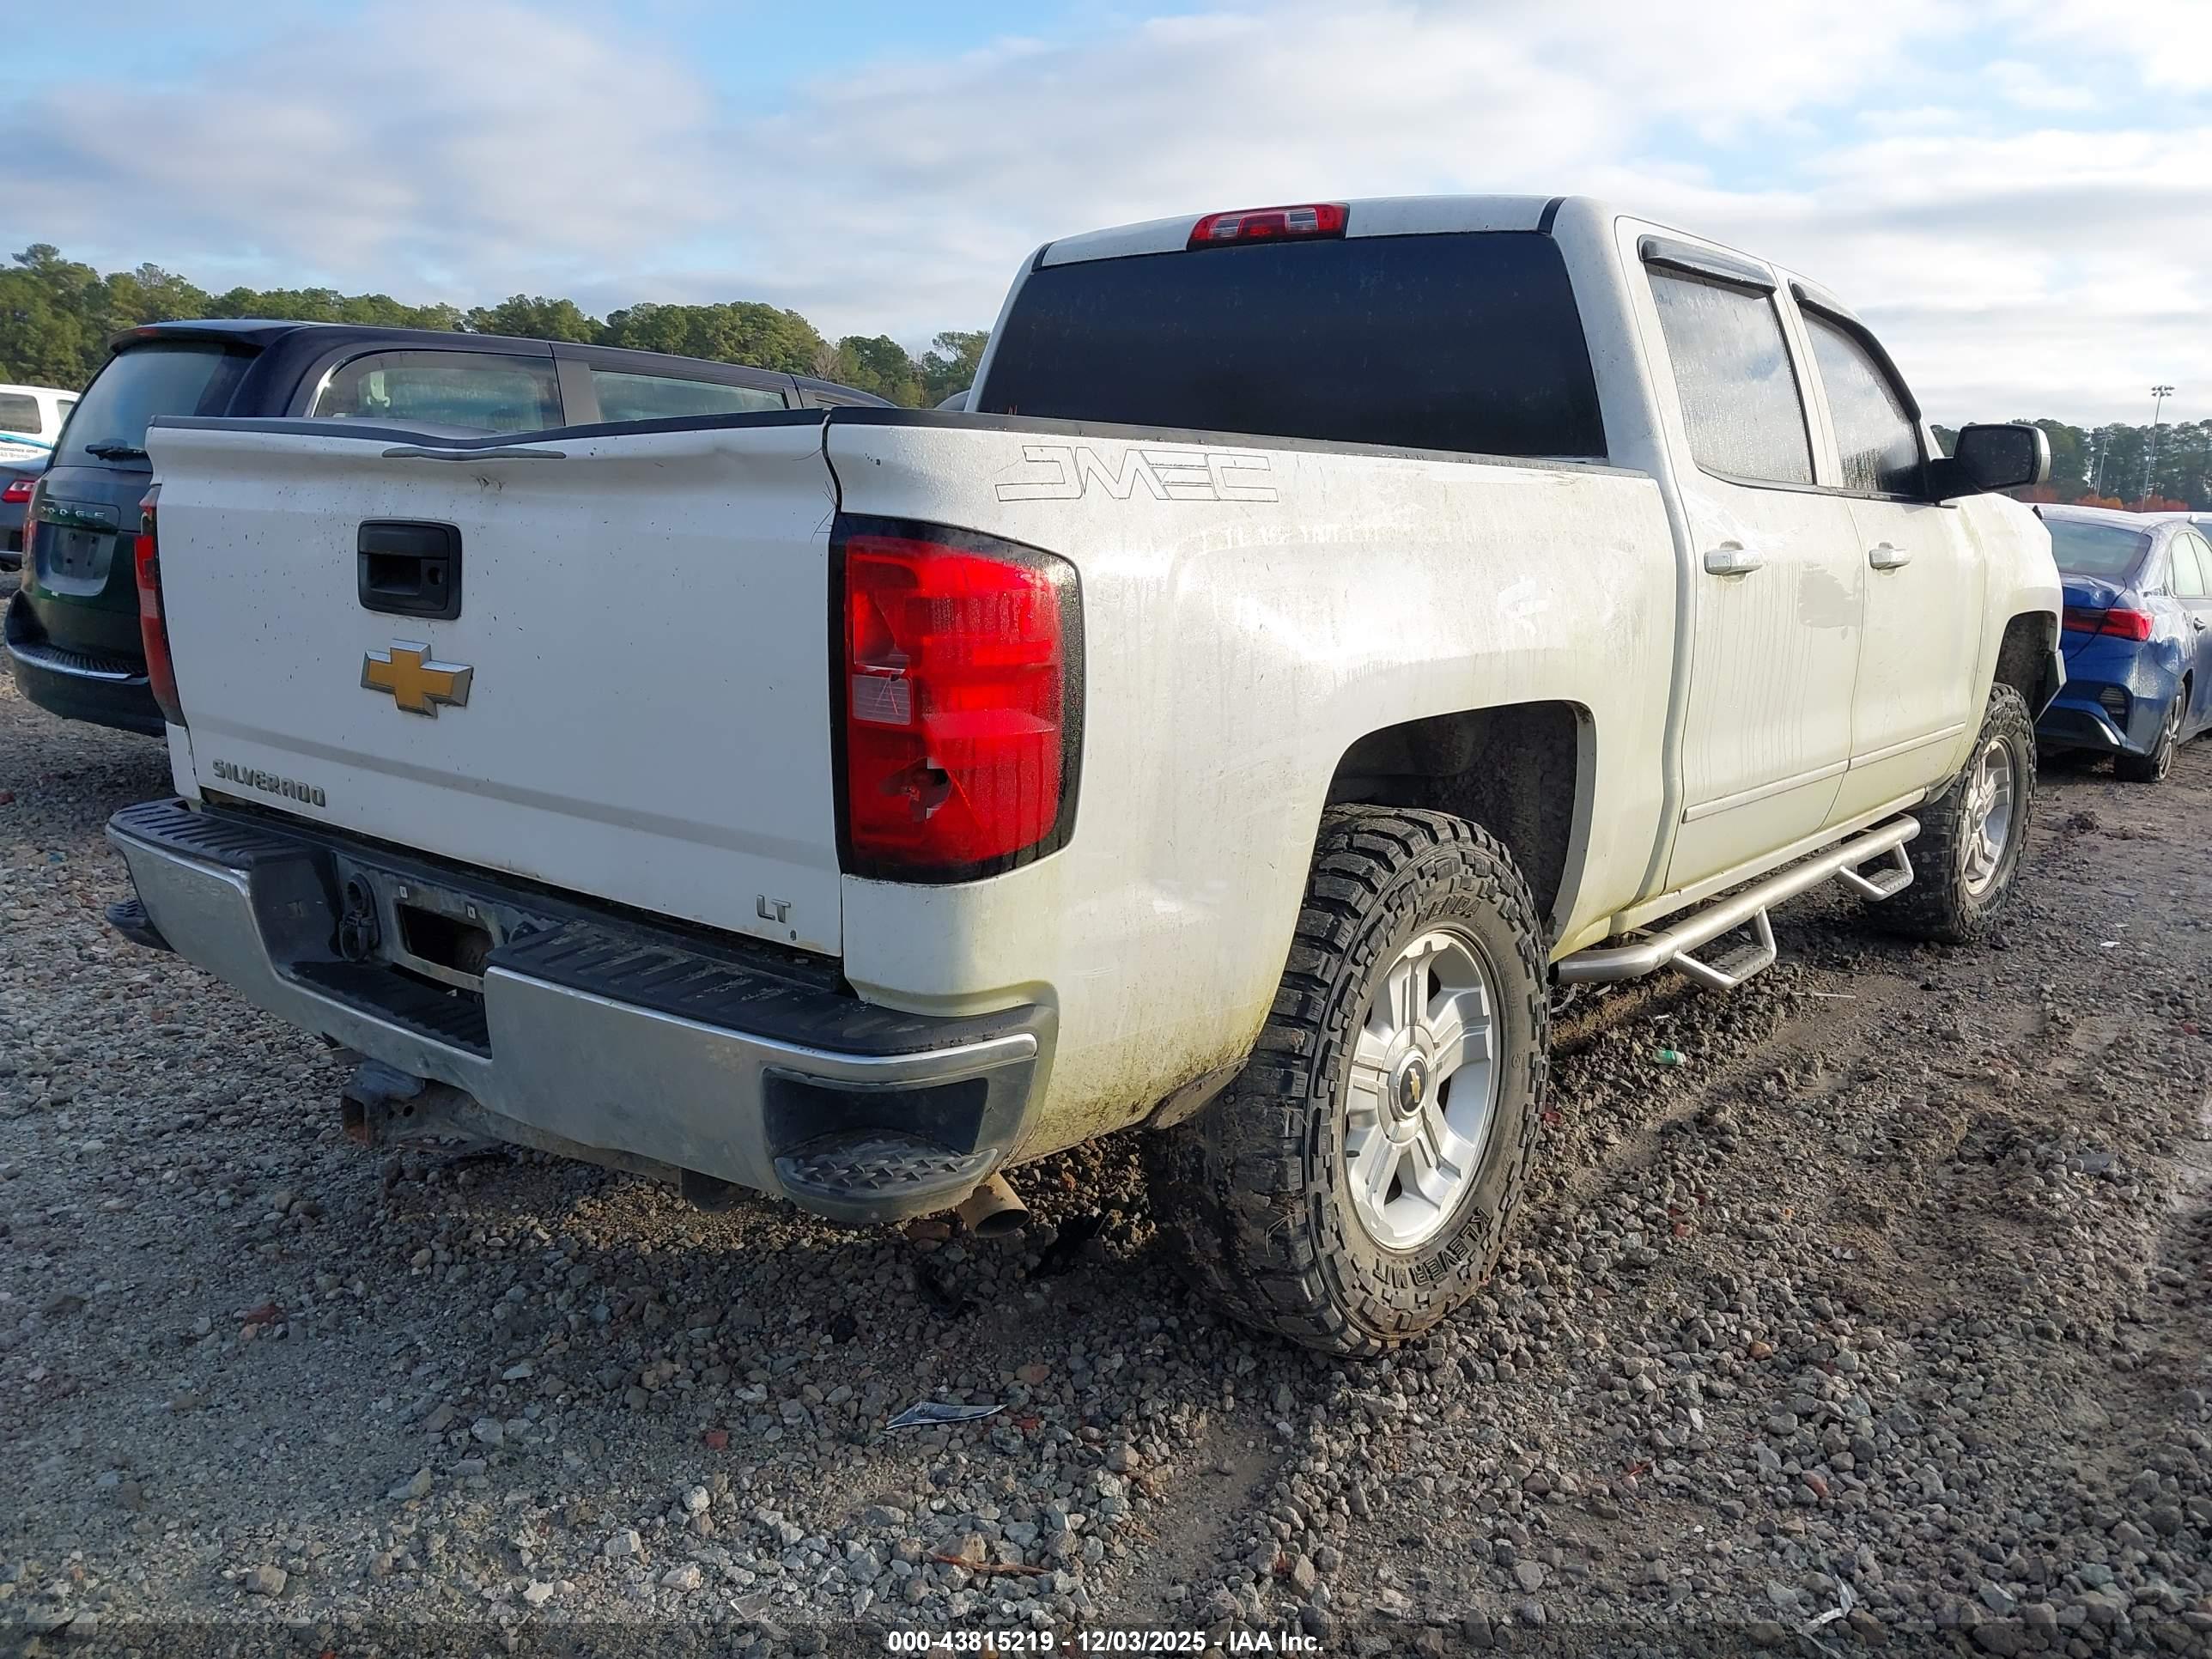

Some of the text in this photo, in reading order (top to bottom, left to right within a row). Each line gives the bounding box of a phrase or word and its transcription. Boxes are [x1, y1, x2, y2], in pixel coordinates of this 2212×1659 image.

[40, 506, 105, 519] DODGE
[213, 758, 325, 807] SILVERADO
[756, 894, 792, 923] LT
[1410, 895, 1481, 932] KENDA
[1408, 1206, 1491, 1285] KLEVER
